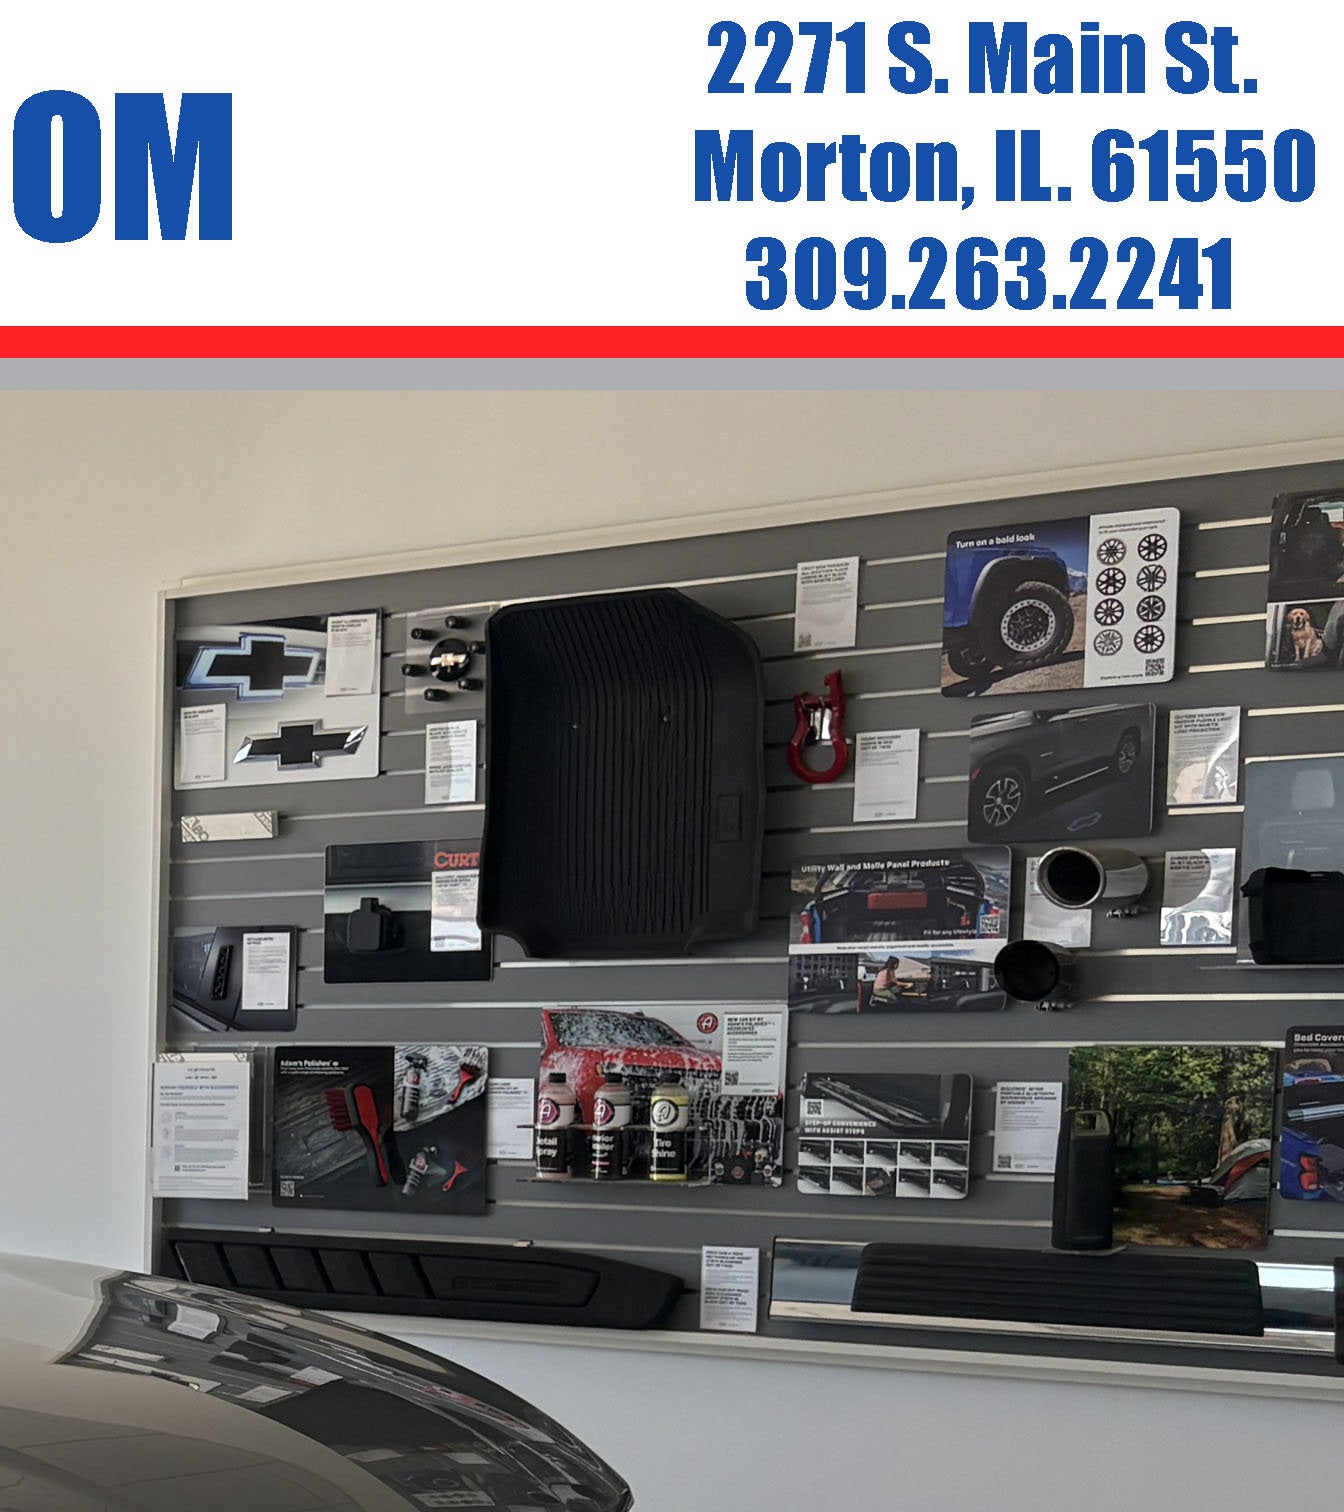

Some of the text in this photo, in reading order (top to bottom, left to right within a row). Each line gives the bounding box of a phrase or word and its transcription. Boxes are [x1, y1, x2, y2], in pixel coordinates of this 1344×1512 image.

[956, 540, 975, 549] Turn
[976, 539, 987, 547] on
[996, 534, 1015, 545] bold
[1016, 532, 1035, 542] look
[434, 851, 480, 869] CURT
[801, 864, 826, 873] Utility
[827, 863, 845, 872] Wall
[846, 863, 861, 871] and
[886, 860, 910, 869] Panel
[911, 859, 950, 868] Products
[1294, 1033, 1344, 1041] Bed Cover
